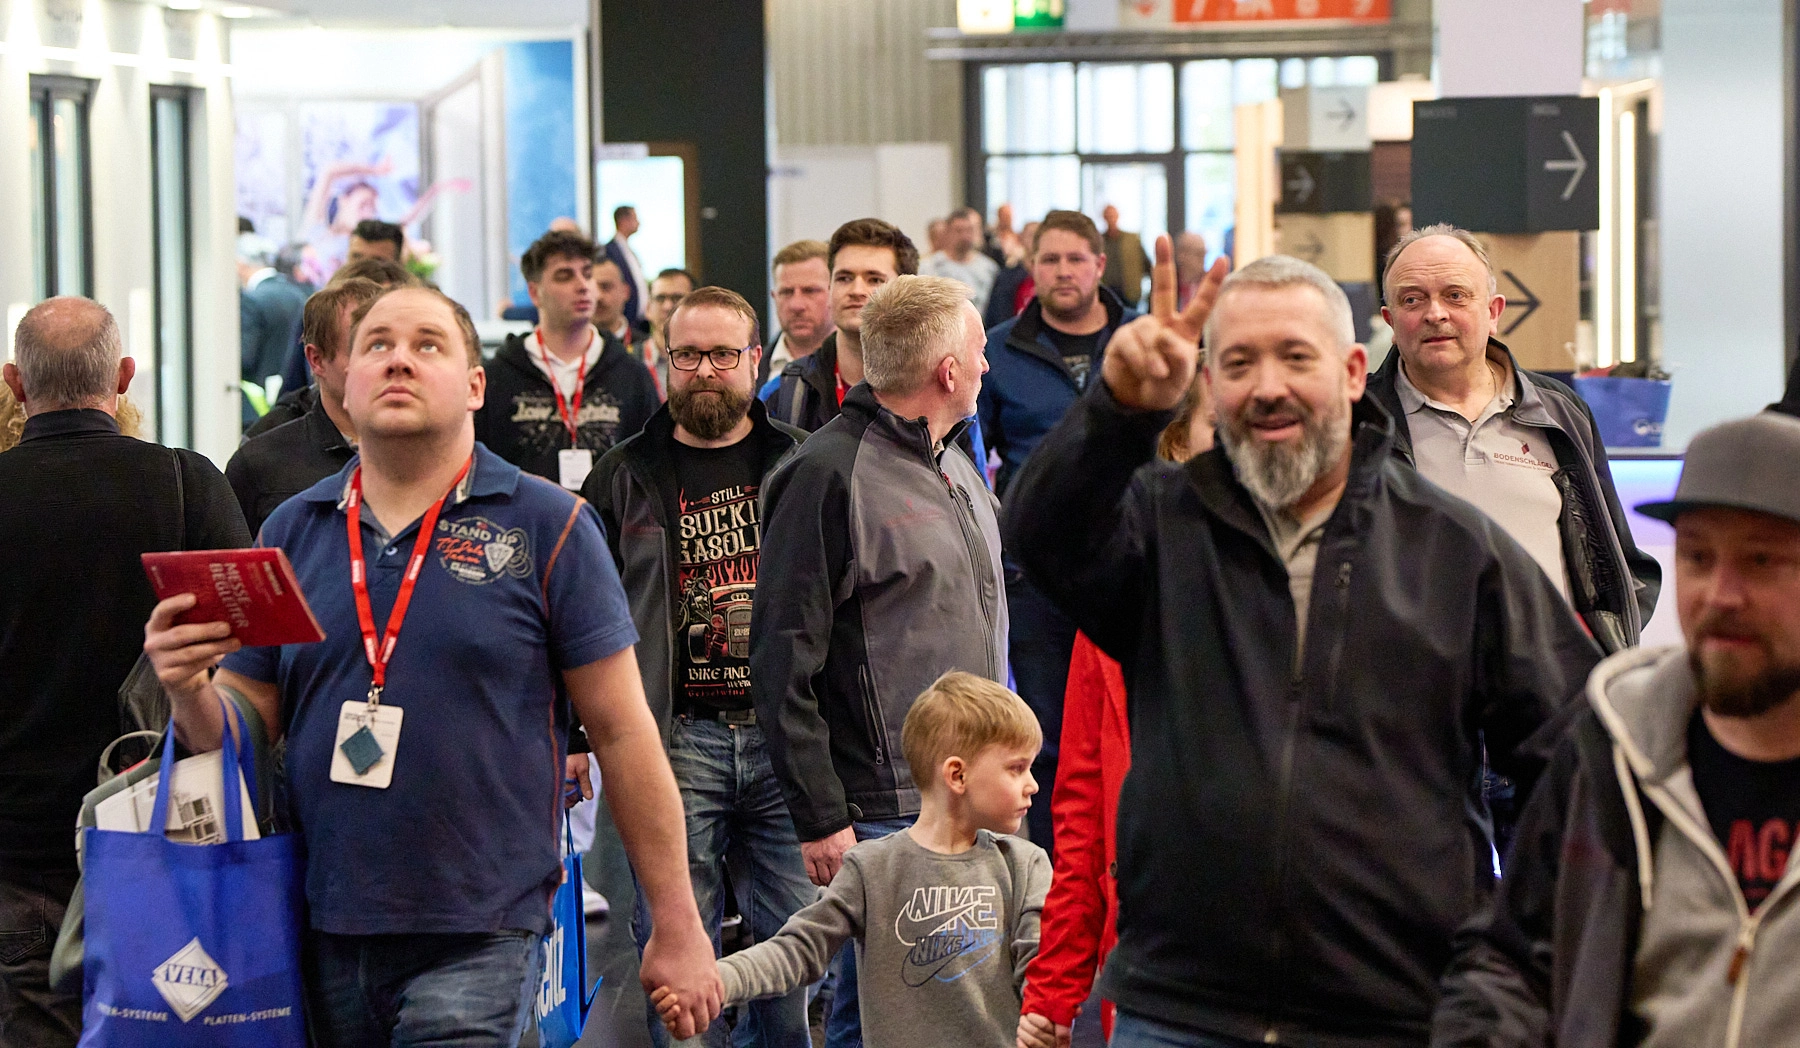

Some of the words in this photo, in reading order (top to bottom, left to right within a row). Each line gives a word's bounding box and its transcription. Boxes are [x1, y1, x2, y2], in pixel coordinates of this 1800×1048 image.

[711, 485, 745, 504] STILL
[680, 498, 761, 539] SUCKI
[438, 519, 492, 541] STAND
[495, 532, 519, 545] UP
[688, 667, 721, 681] BIKE
[723, 666, 751, 680] AND
[909, 886, 998, 930] NIKE
[911, 935, 964, 966] NIKE
[165, 963, 219, 988] VEKA
[203, 1006, 292, 1026] PLATTEN-SYSTEME
